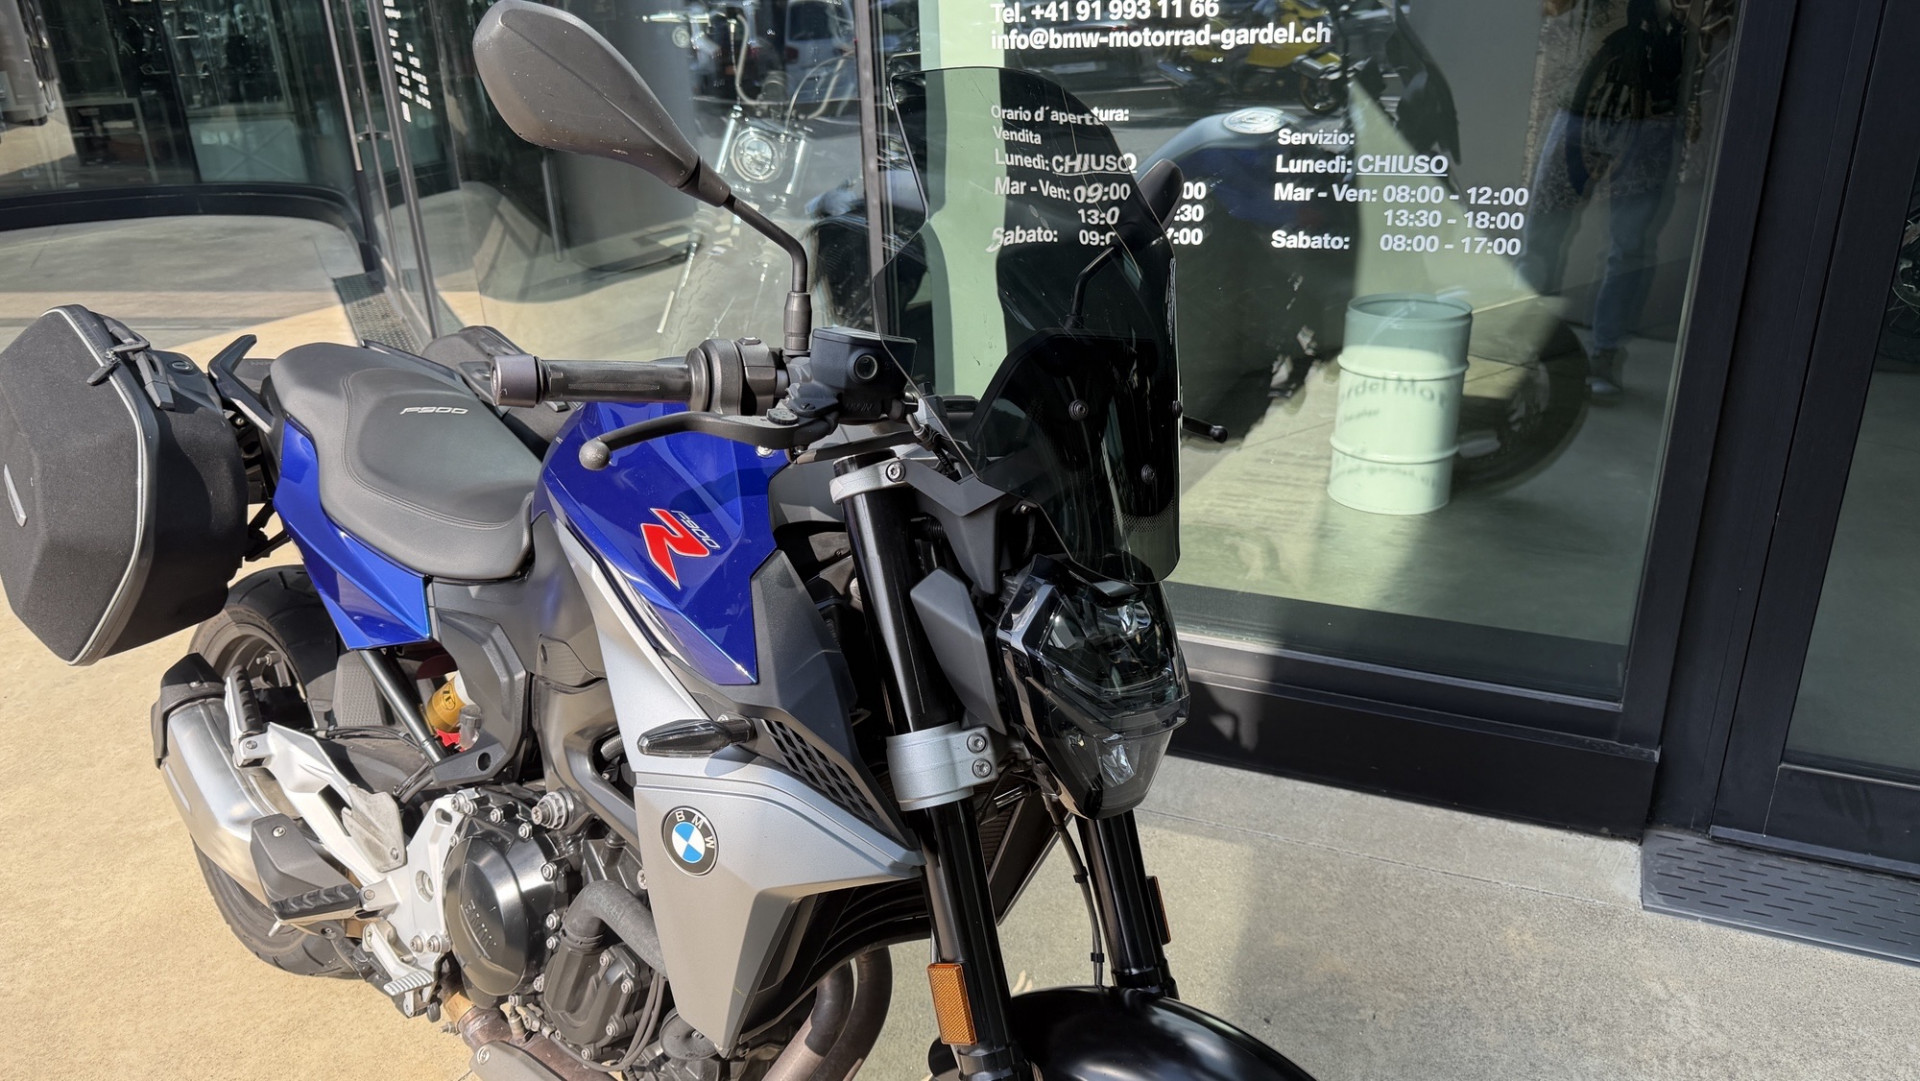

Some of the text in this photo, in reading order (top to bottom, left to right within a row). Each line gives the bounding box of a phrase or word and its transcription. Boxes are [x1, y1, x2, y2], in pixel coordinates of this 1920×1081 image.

[991, 0, 1220, 24] Tel. +41 91 993 11 66
[991, 22, 1331, 50] info@bmw-motorrad-gardel.ch
[991, 105, 1032, 121] Orario
[993, 126, 1042, 145] Vendita
[1277, 128, 1355, 145] Servizio:
[995, 148, 1138, 175] Lunedì: CHIUSO
[1276, 154, 1449, 176] Lunedì: CHIUSO
[994, 177, 1027, 195] Mar
[1039, 179, 1071, 201] Ven:
[1073, 182, 1131, 204] 09:00
[1274, 183, 1315, 202] Mar
[1332, 184, 1378, 203] Ven:
[1382, 185, 1445, 204] 08:00
[1466, 187, 1530, 206] 12:00
[1077, 206, 1120, 226] 13:0
[1383, 209, 1442, 228] 13:30
[1463, 212, 1525, 231] 18:00
[985, 225, 1059, 253] Sabato:
[1271, 230, 1351, 250] Sabato:
[1379, 234, 1440, 253] 08:00
[1460, 237, 1522, 256] 17:00
[400, 406, 469, 415] F900
[671, 510, 721, 550] F900
[674, 810, 716, 850] BMW
